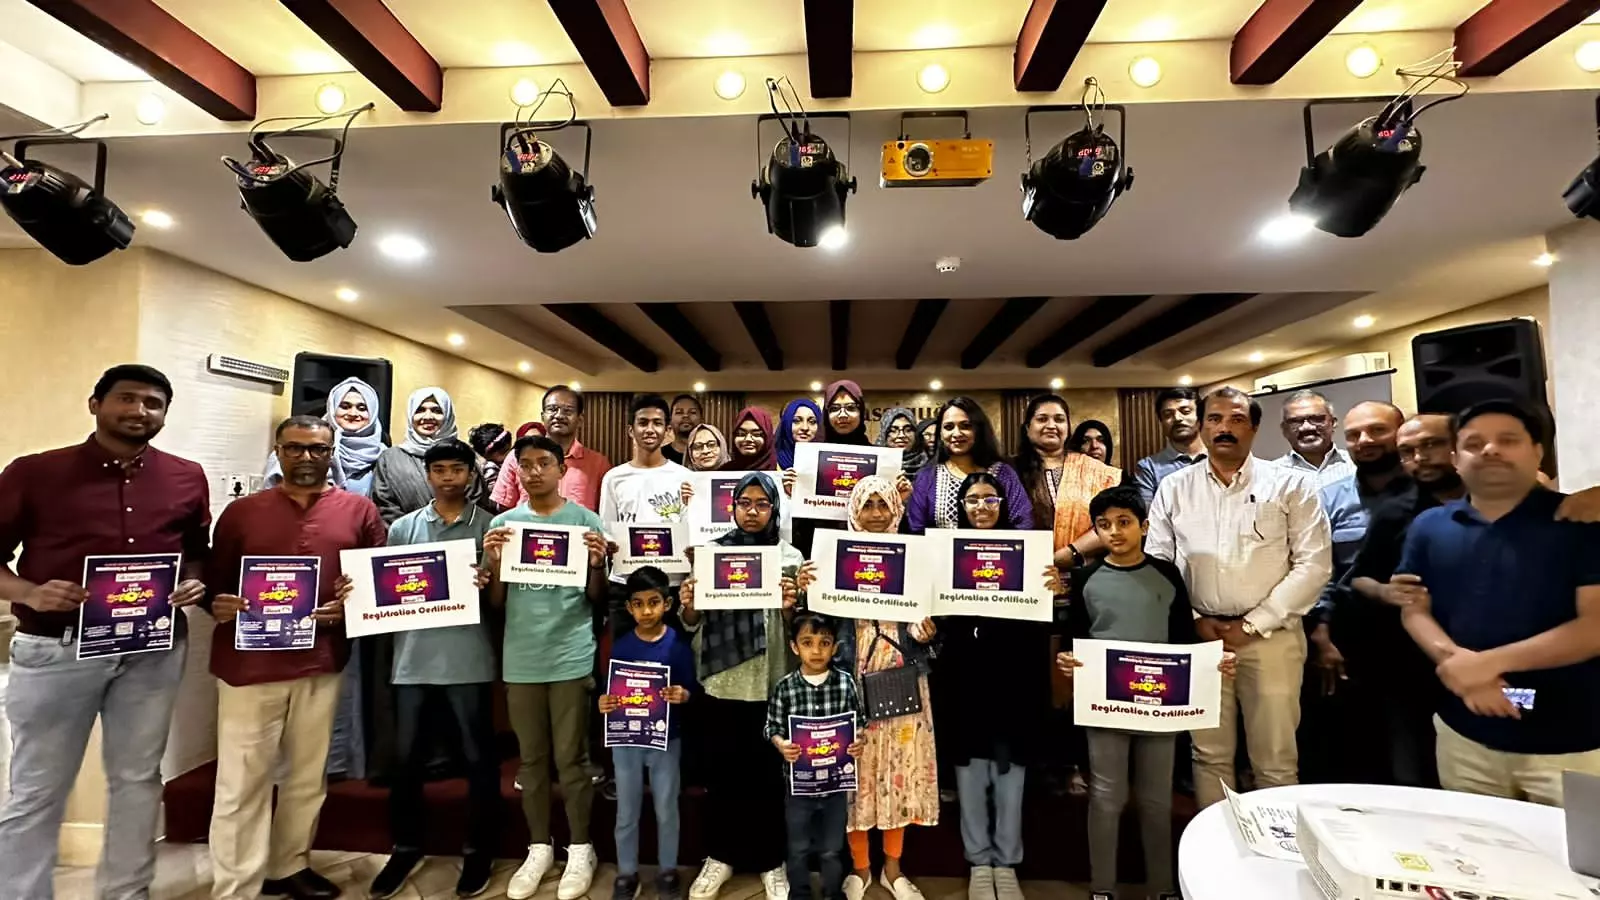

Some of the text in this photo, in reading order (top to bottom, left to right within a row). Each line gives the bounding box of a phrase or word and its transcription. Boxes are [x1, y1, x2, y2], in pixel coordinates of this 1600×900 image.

[803, 498, 846, 508] Registration
[821, 592, 919, 608] Registration Certificate
[939, 592, 1039, 605] Registration Certificate
[362, 603, 466, 622] Registration Certificate
[1091, 703, 1205, 718] Registration Certificate
